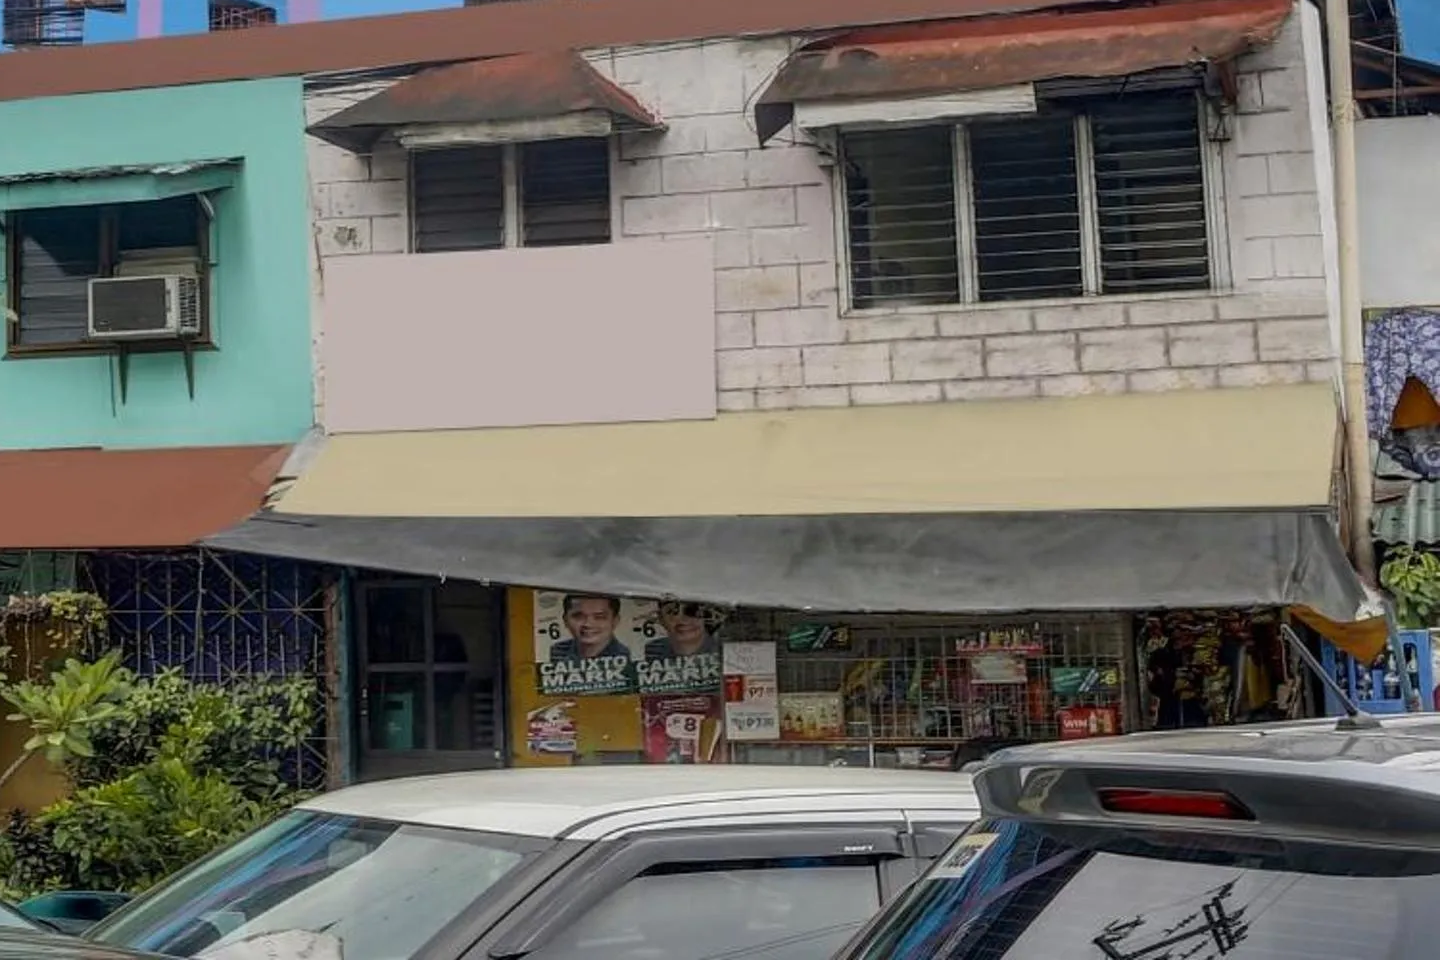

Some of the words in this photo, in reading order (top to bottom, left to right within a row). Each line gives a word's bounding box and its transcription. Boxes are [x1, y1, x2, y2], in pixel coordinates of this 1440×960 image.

[540, 655, 627, 675] CALIXTO
[542, 668, 625, 687] MARK
[638, 665, 720, 686] MARK
[1063, 719, 1088, 728] WIN
